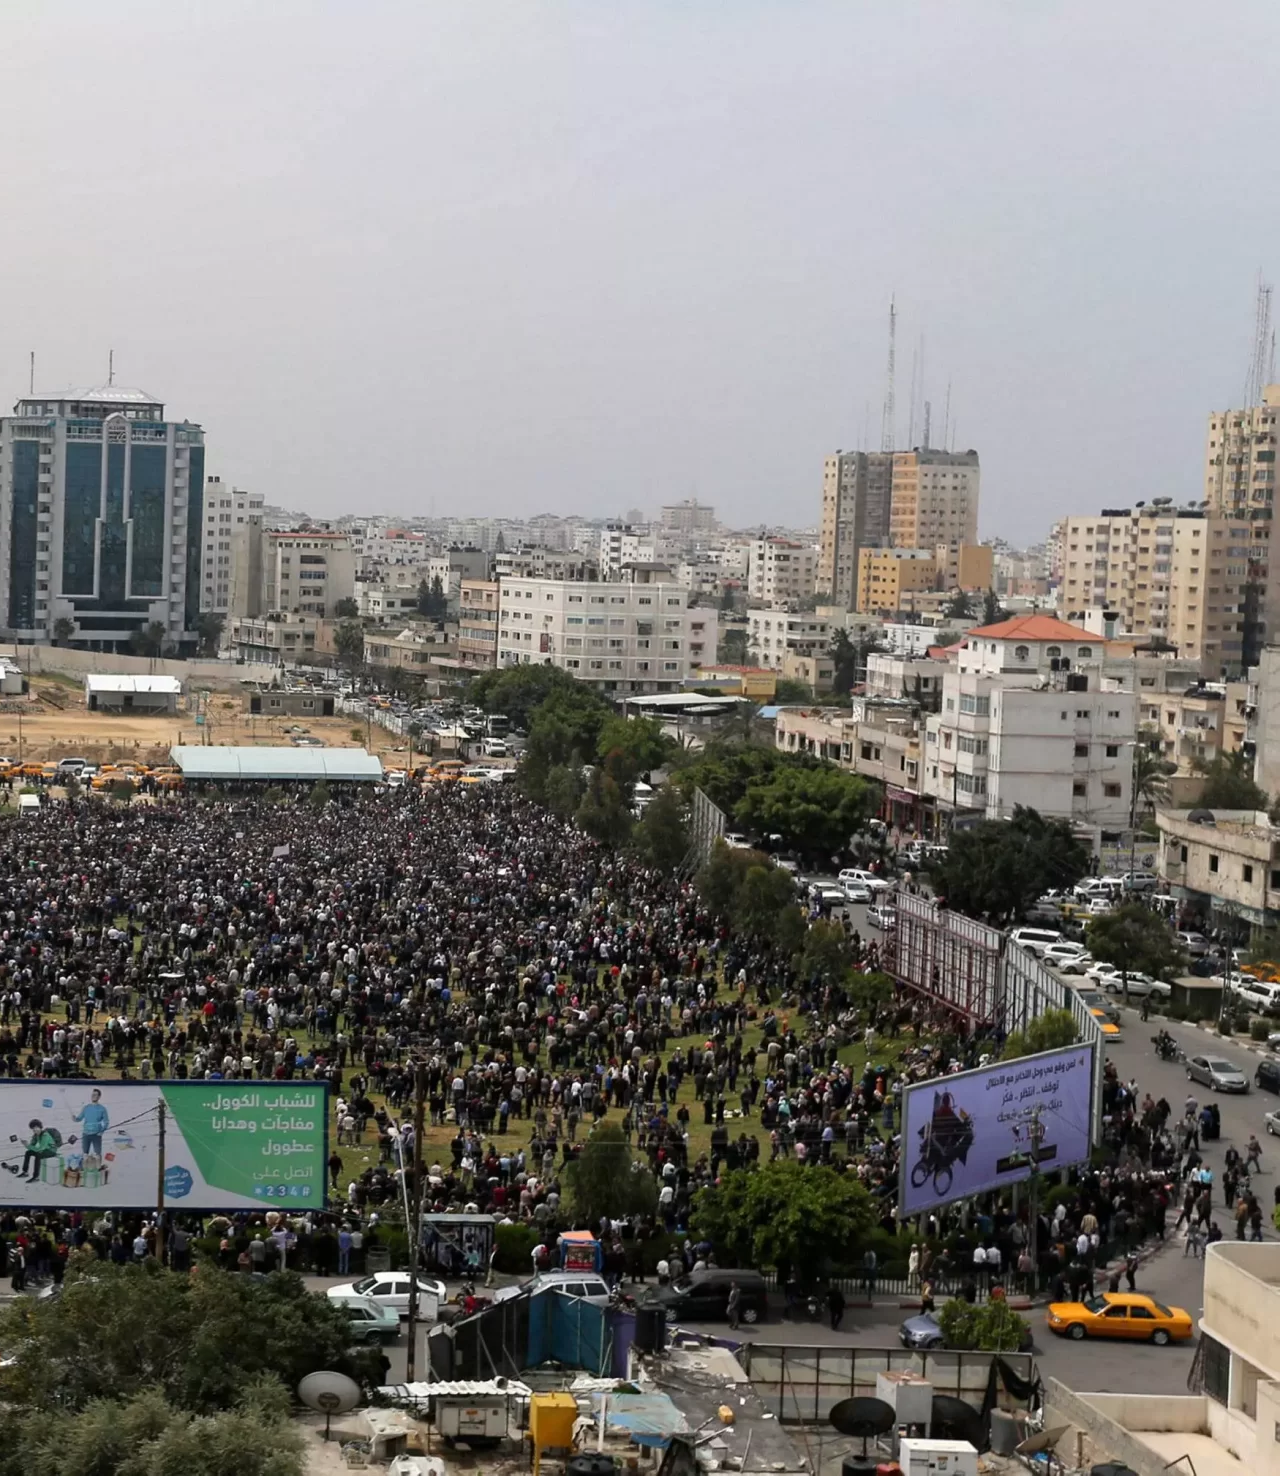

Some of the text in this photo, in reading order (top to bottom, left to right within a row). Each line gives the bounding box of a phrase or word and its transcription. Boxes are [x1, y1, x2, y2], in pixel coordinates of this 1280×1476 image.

[264, 1092, 316, 1111] للشباب
[212, 1113, 314, 1133] مفاجآت وهدايا
[262, 1140, 314, 1155] عطوول
[253, 1165, 313, 1180] اتصل على
